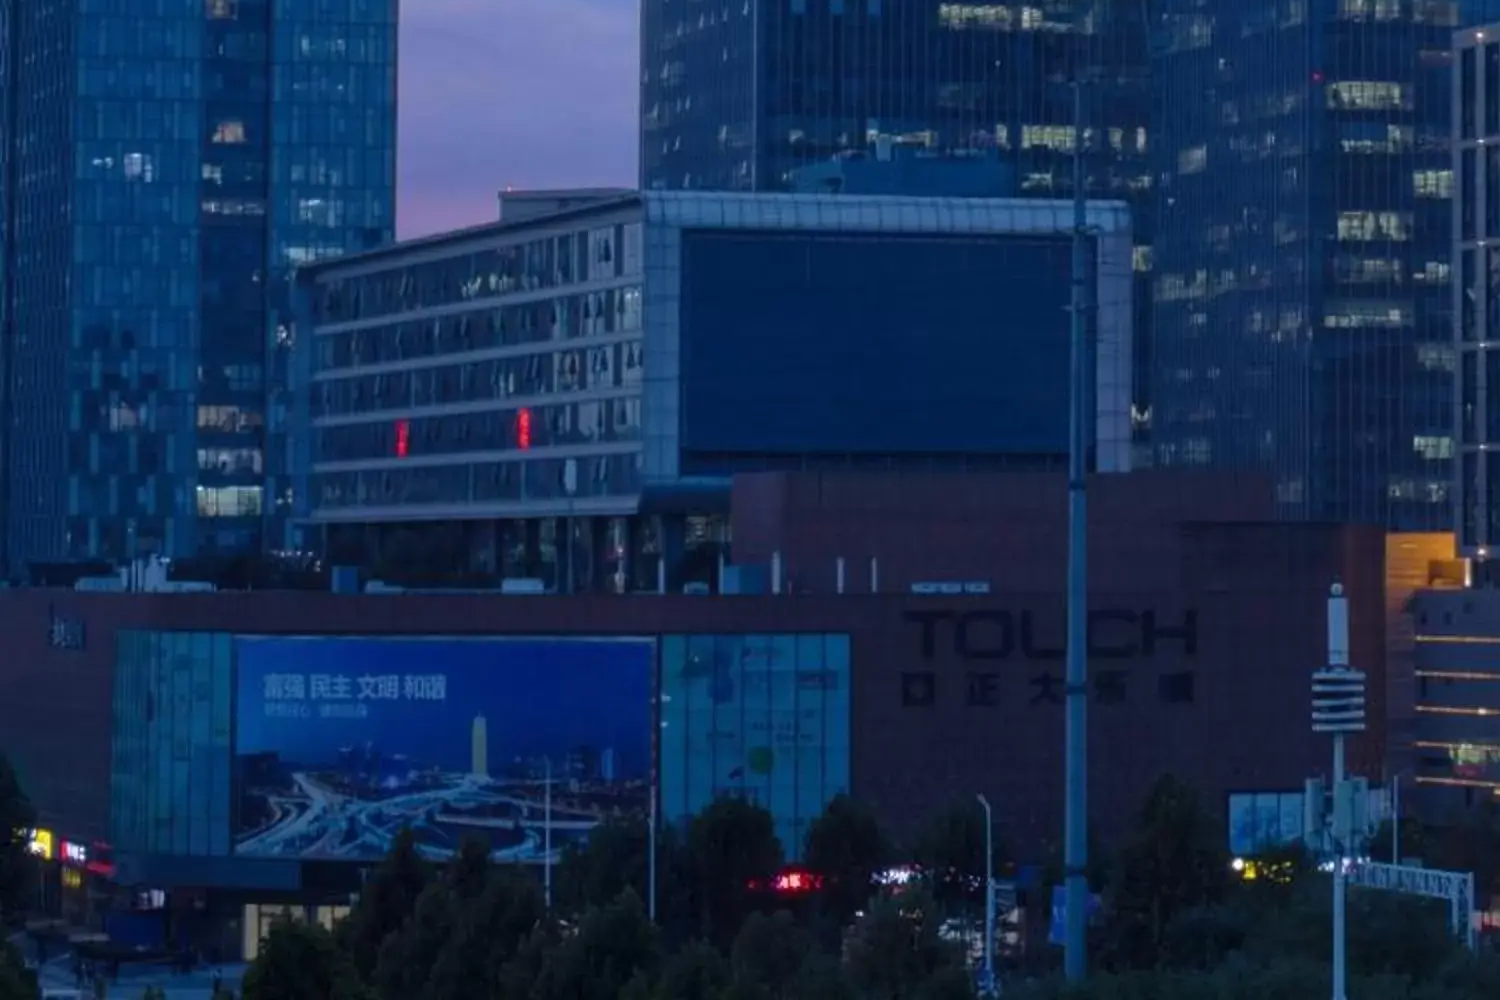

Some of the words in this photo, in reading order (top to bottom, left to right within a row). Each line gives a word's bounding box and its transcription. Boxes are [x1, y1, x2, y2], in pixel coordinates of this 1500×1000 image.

[902, 607, 1197, 659] TOUCH
[263, 673, 305, 700] 富强
[310, 673, 353, 700] 民主
[356, 673, 399, 701] 文明
[402, 673, 447, 701] 和谐
